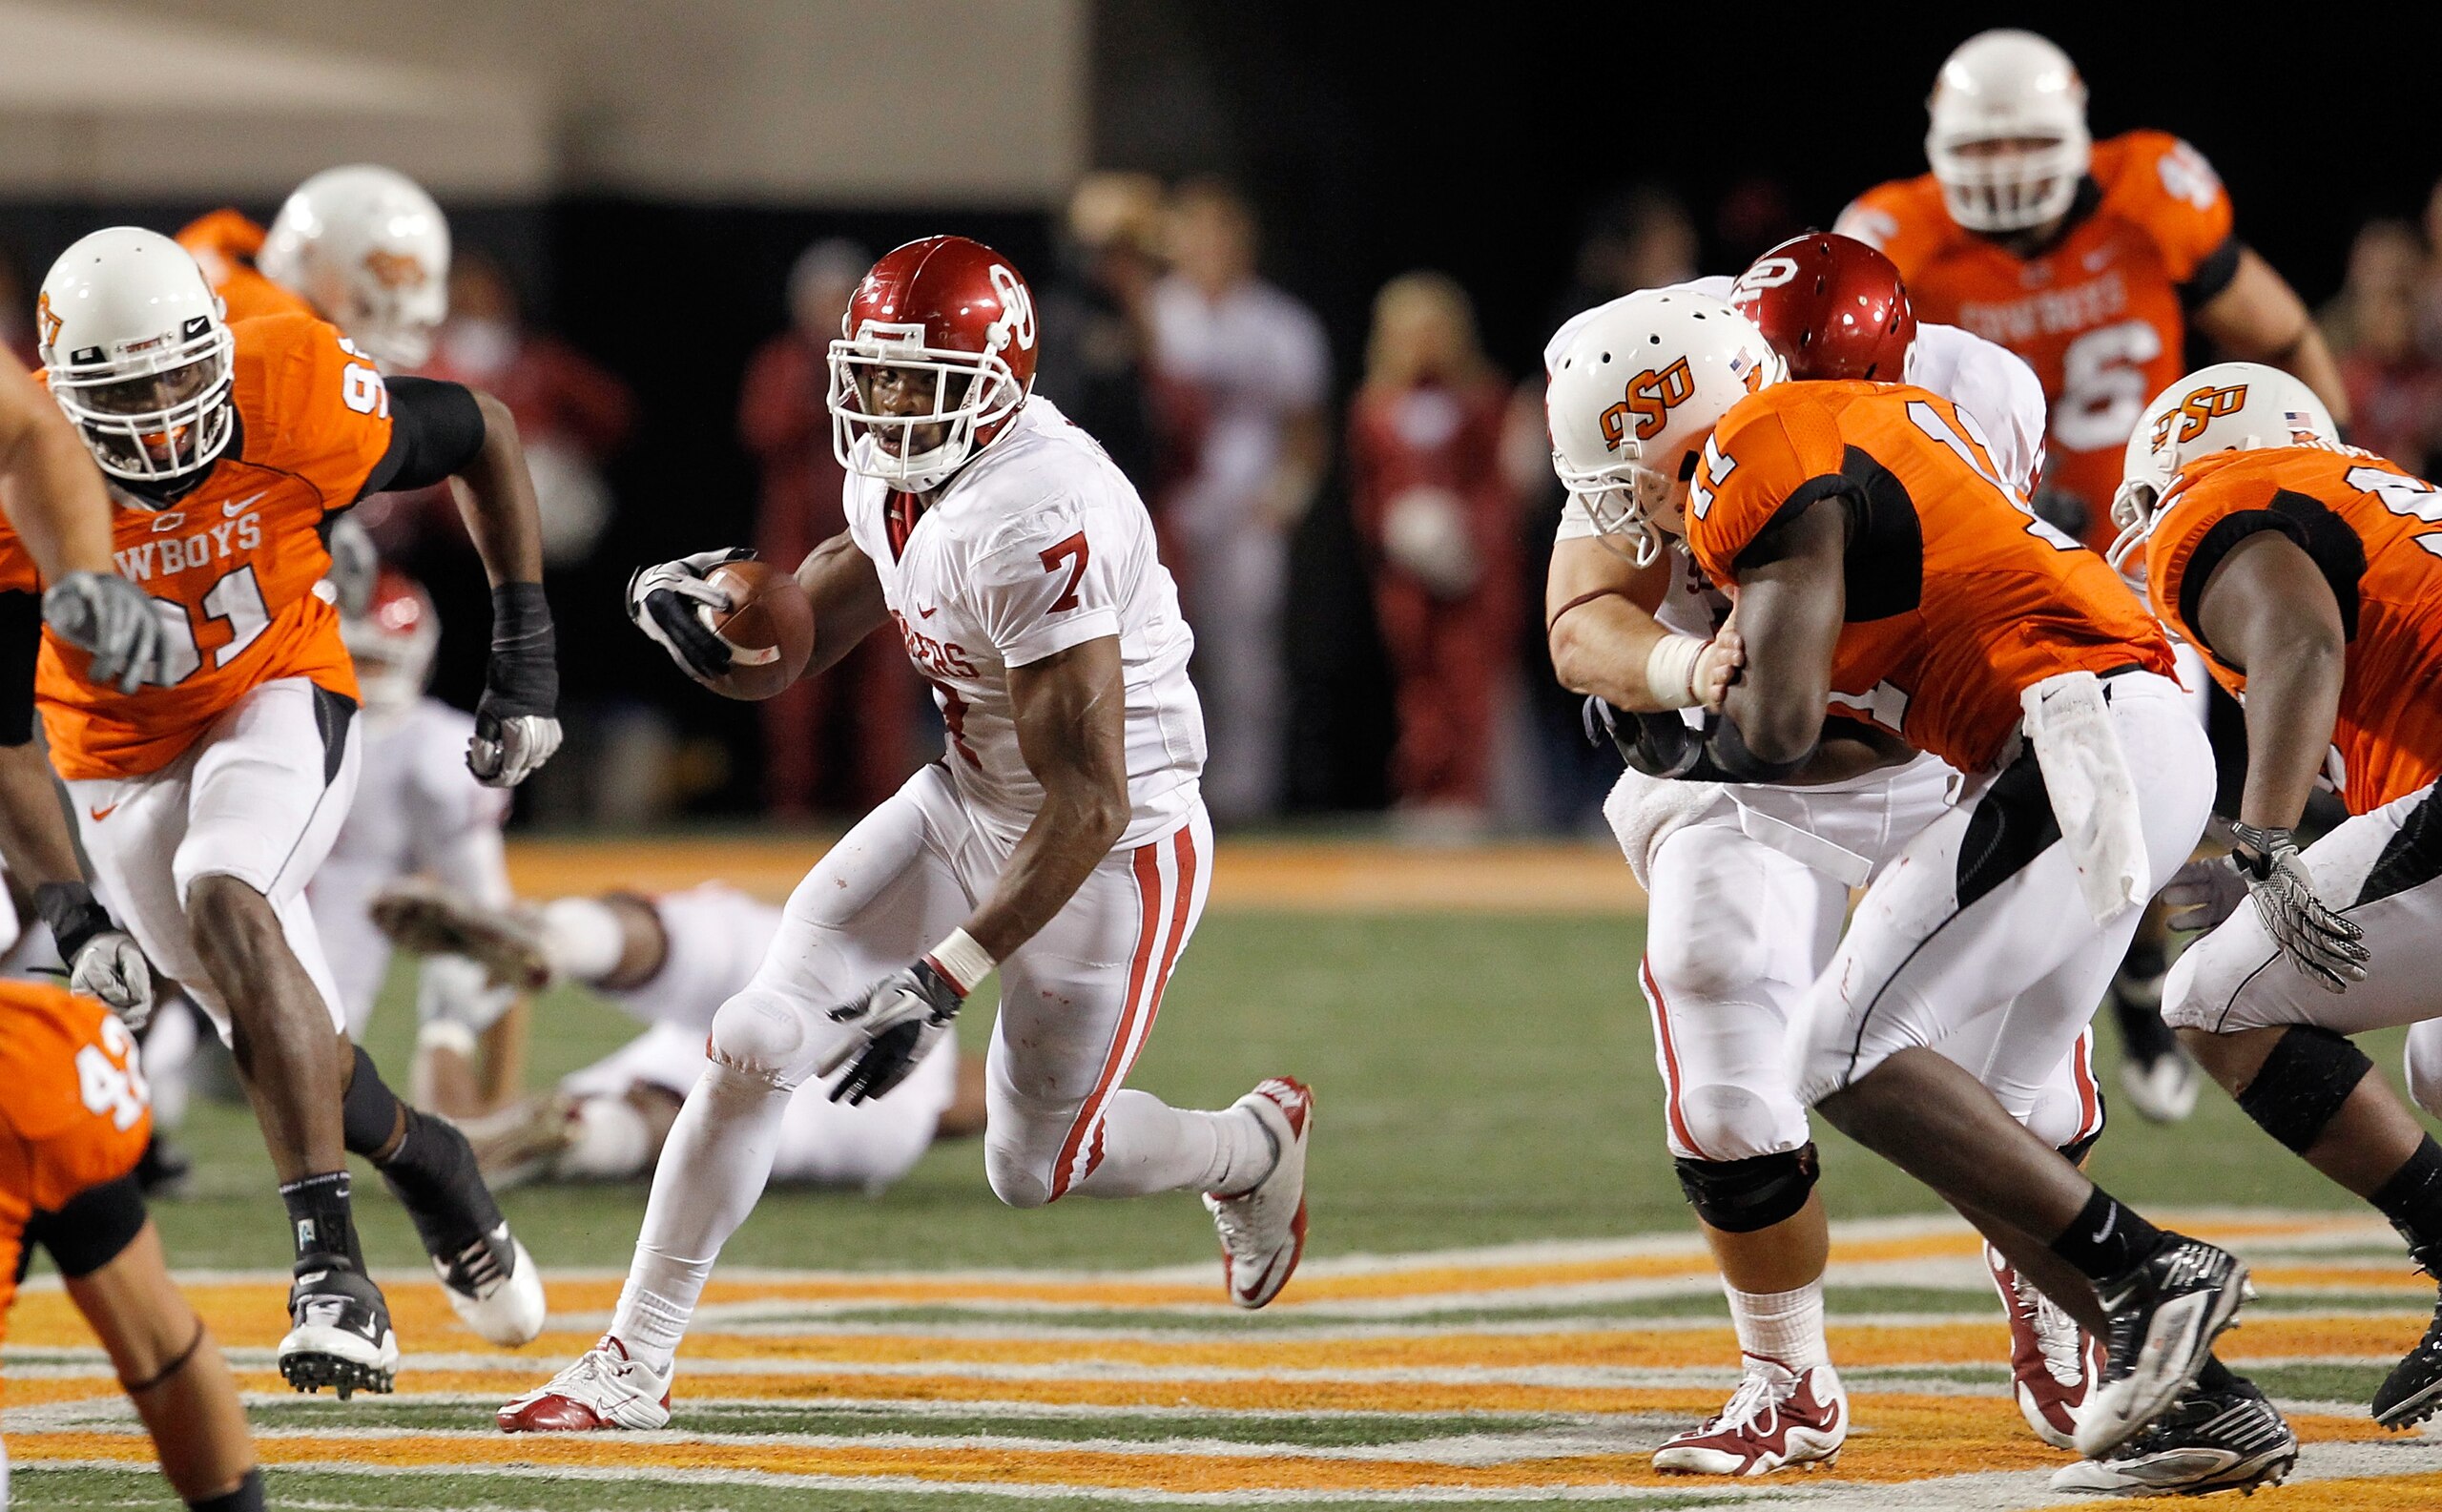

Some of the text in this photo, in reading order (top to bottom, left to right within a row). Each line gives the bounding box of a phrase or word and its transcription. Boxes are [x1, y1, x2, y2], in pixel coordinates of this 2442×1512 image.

[1599, 355, 1696, 452] OSU
[2053, 320, 2162, 451] 6
[2151, 383, 2249, 456] OSU
[112, 511, 262, 584] WBOYS
[1037, 529, 1090, 615] 7
